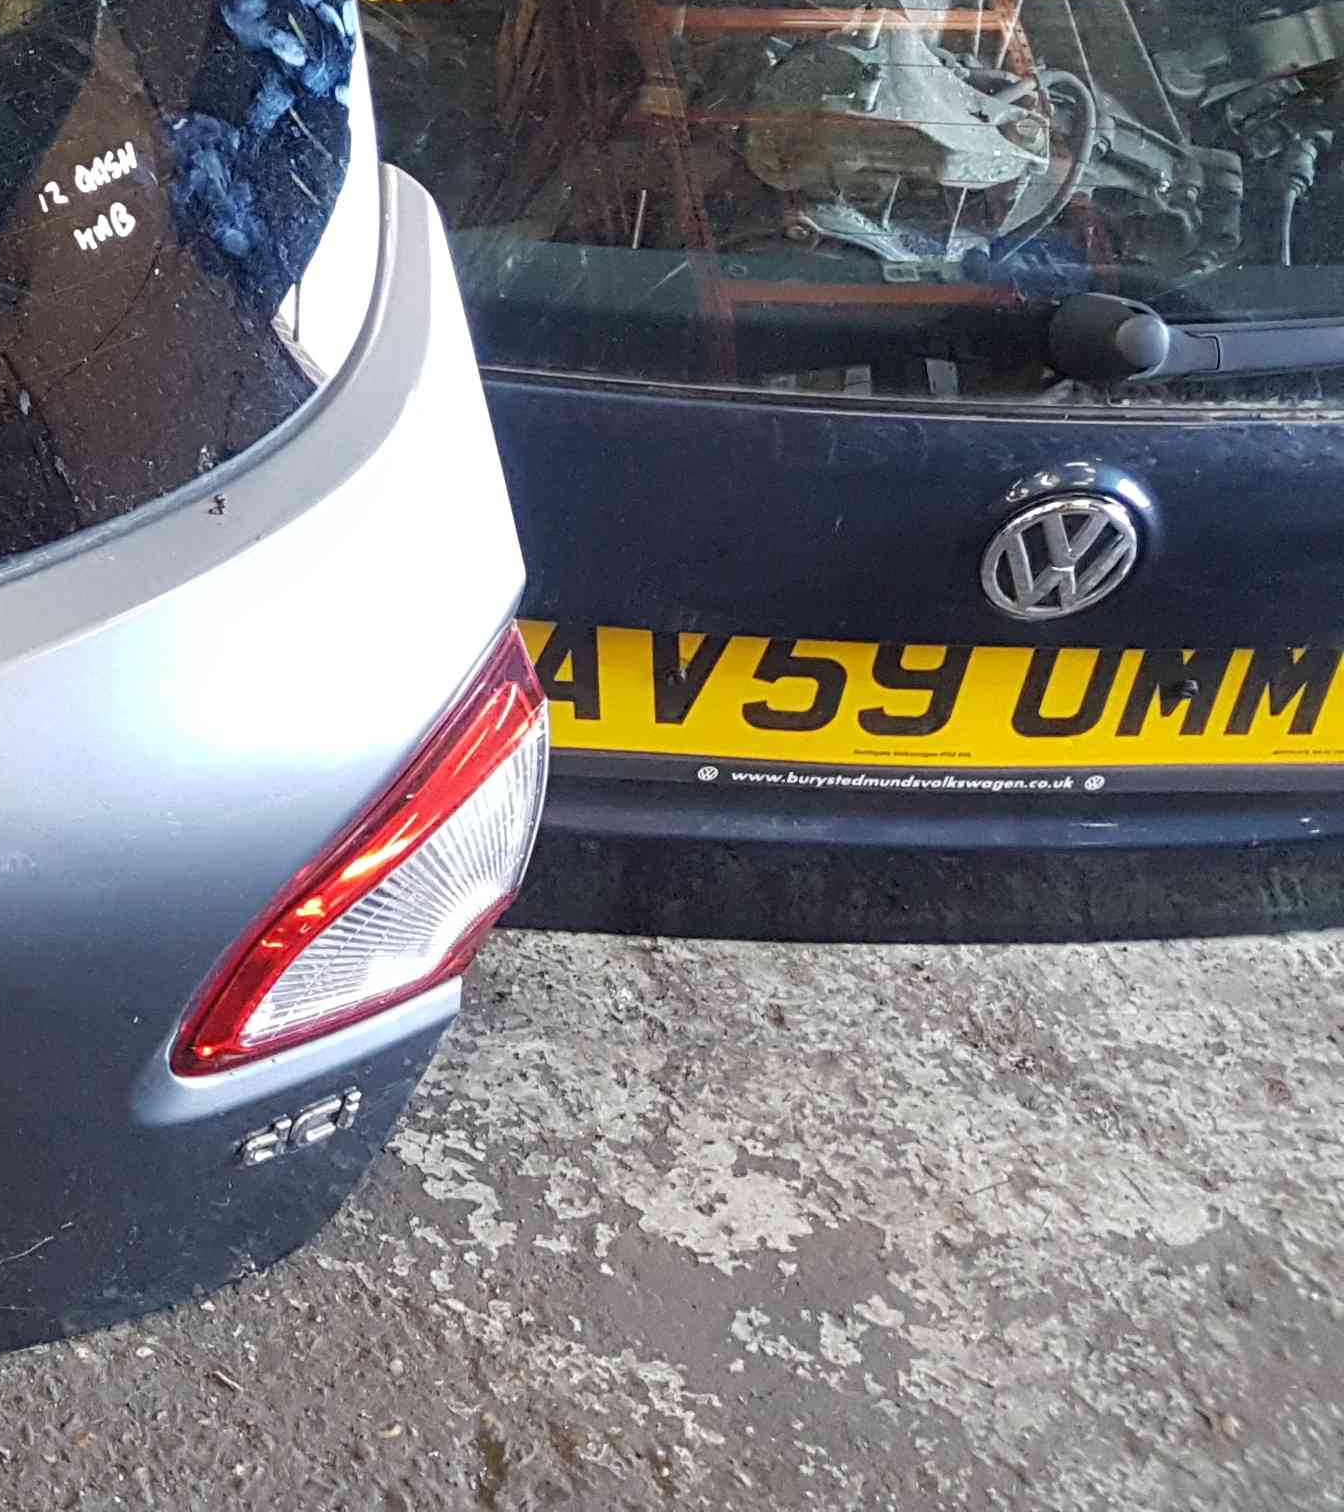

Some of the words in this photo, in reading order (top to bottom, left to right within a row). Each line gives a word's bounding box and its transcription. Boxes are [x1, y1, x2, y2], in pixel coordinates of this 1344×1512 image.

[38, 180, 70, 213] 12
[534, 622, 976, 738] AV59
[730, 770, 1075, 792] www.burystedmundsvolkswagen.co.uk
